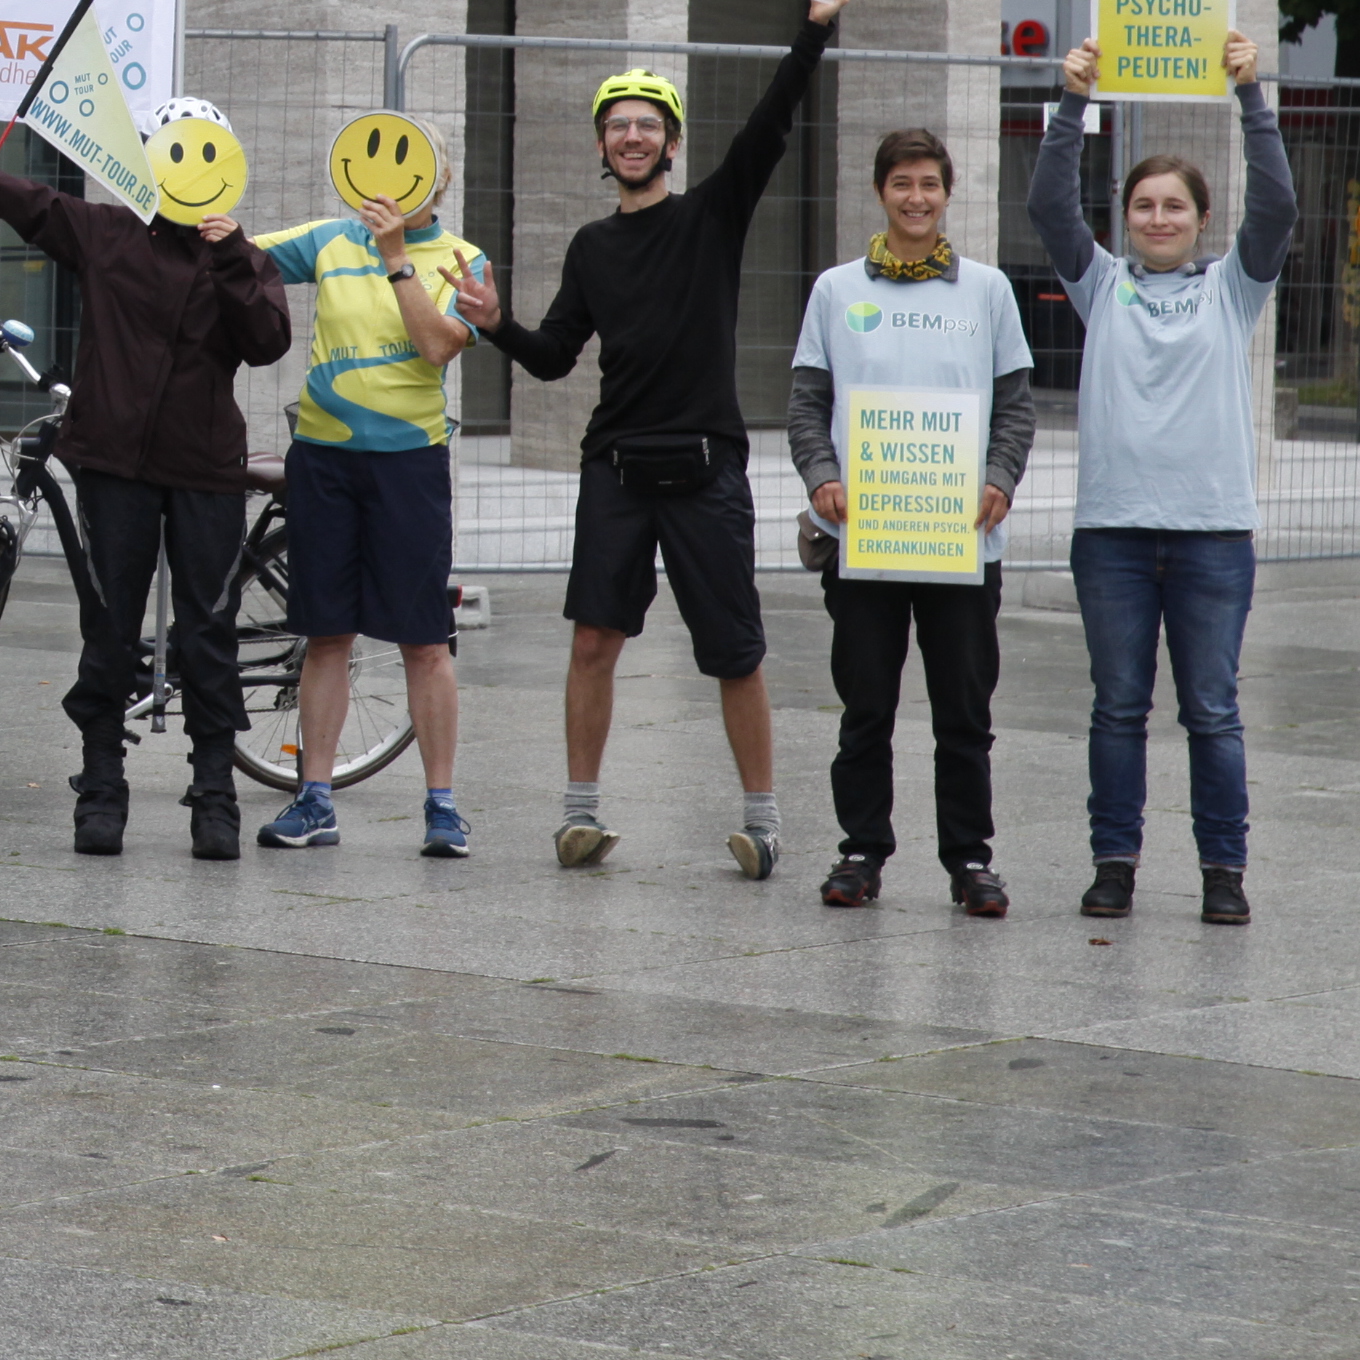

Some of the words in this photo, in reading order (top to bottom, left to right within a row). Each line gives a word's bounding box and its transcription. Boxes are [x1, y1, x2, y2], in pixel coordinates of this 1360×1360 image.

[103, 26, 118, 45] UT
[1124, 25, 1202, 48] THERA-
[109, 39, 133, 64] OUR
[74, 72, 91, 84] MUT
[1117, 56, 1208, 79] PEUTEN!
[74, 84, 94, 96] TOUR
[29, 96, 155, 211] WWW.MUT-TOUR.DE
[891, 311, 979, 337] BEMpsy
[331, 346, 358, 361] MUT
[860, 409, 914, 431] MEHR
[922, 411, 962, 432] MUT
[860, 441, 873, 461] &
[880, 442, 955, 465] WISSEN
[859, 469, 875, 483] IM
[880, 470, 937, 487] UMGANG
[942, 472, 966, 487] MIT
[859, 494, 964, 515] DEPRESSION
[858, 519, 879, 530] UND
[882, 520, 930, 532] ANDEREN
[933, 522, 970, 534] PSYCH.
[858, 539, 964, 557] ERKRANKUNGEN
